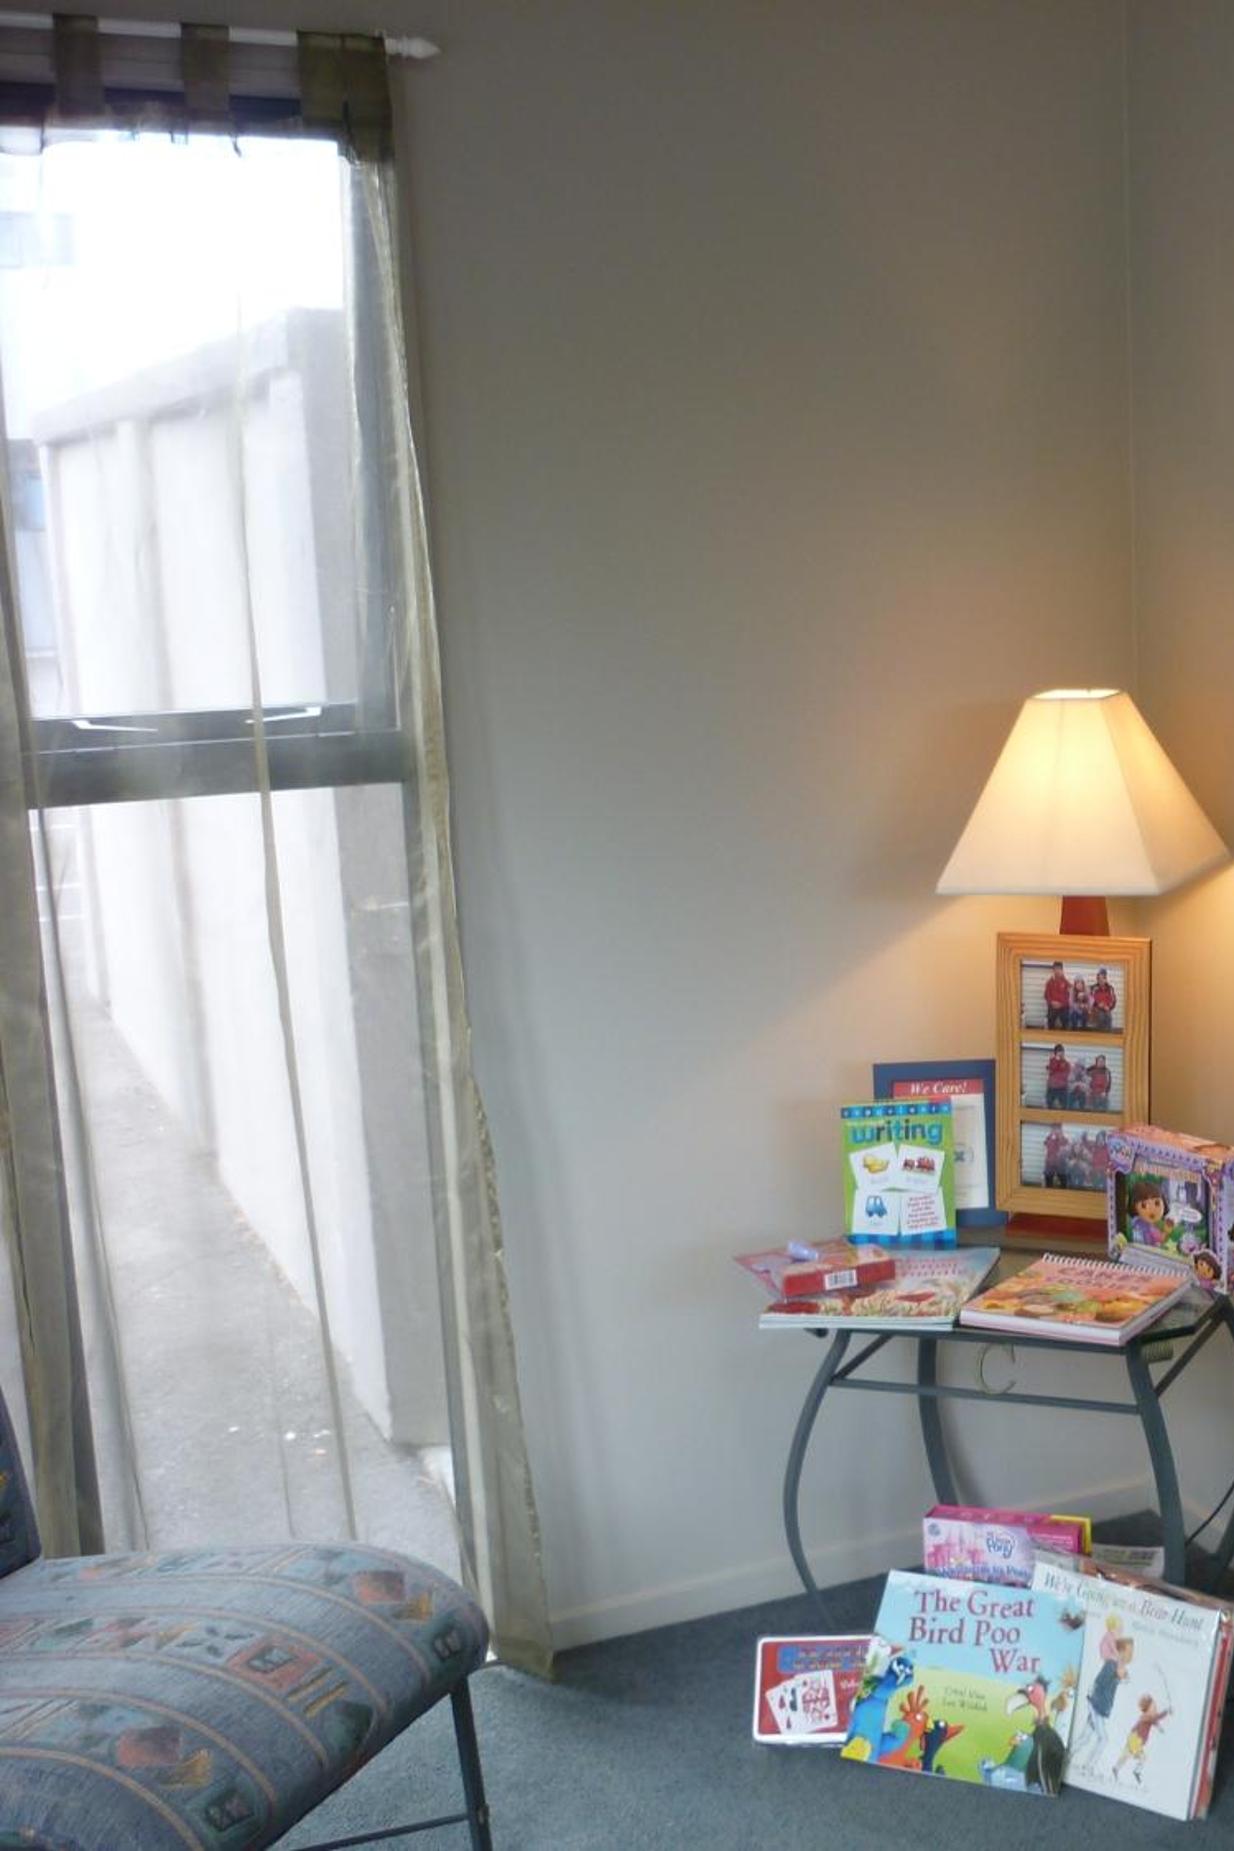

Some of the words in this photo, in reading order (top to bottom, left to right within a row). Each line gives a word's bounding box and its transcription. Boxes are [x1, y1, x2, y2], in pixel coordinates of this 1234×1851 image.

[910, 1081, 928, 1094] We
[931, 1080, 967, 1095] Care!
[850, 1119, 943, 1146] writing
[985, 1536, 1015, 1560] Pony
[913, 1589, 962, 1616] The
[966, 1590, 1035, 1619] Great
[1170, 1606, 1204, 1631] Hunt
[908, 1617, 964, 1645] Bird
[974, 1620, 1022, 1647] Poo
[989, 1648, 1041, 1674] War
